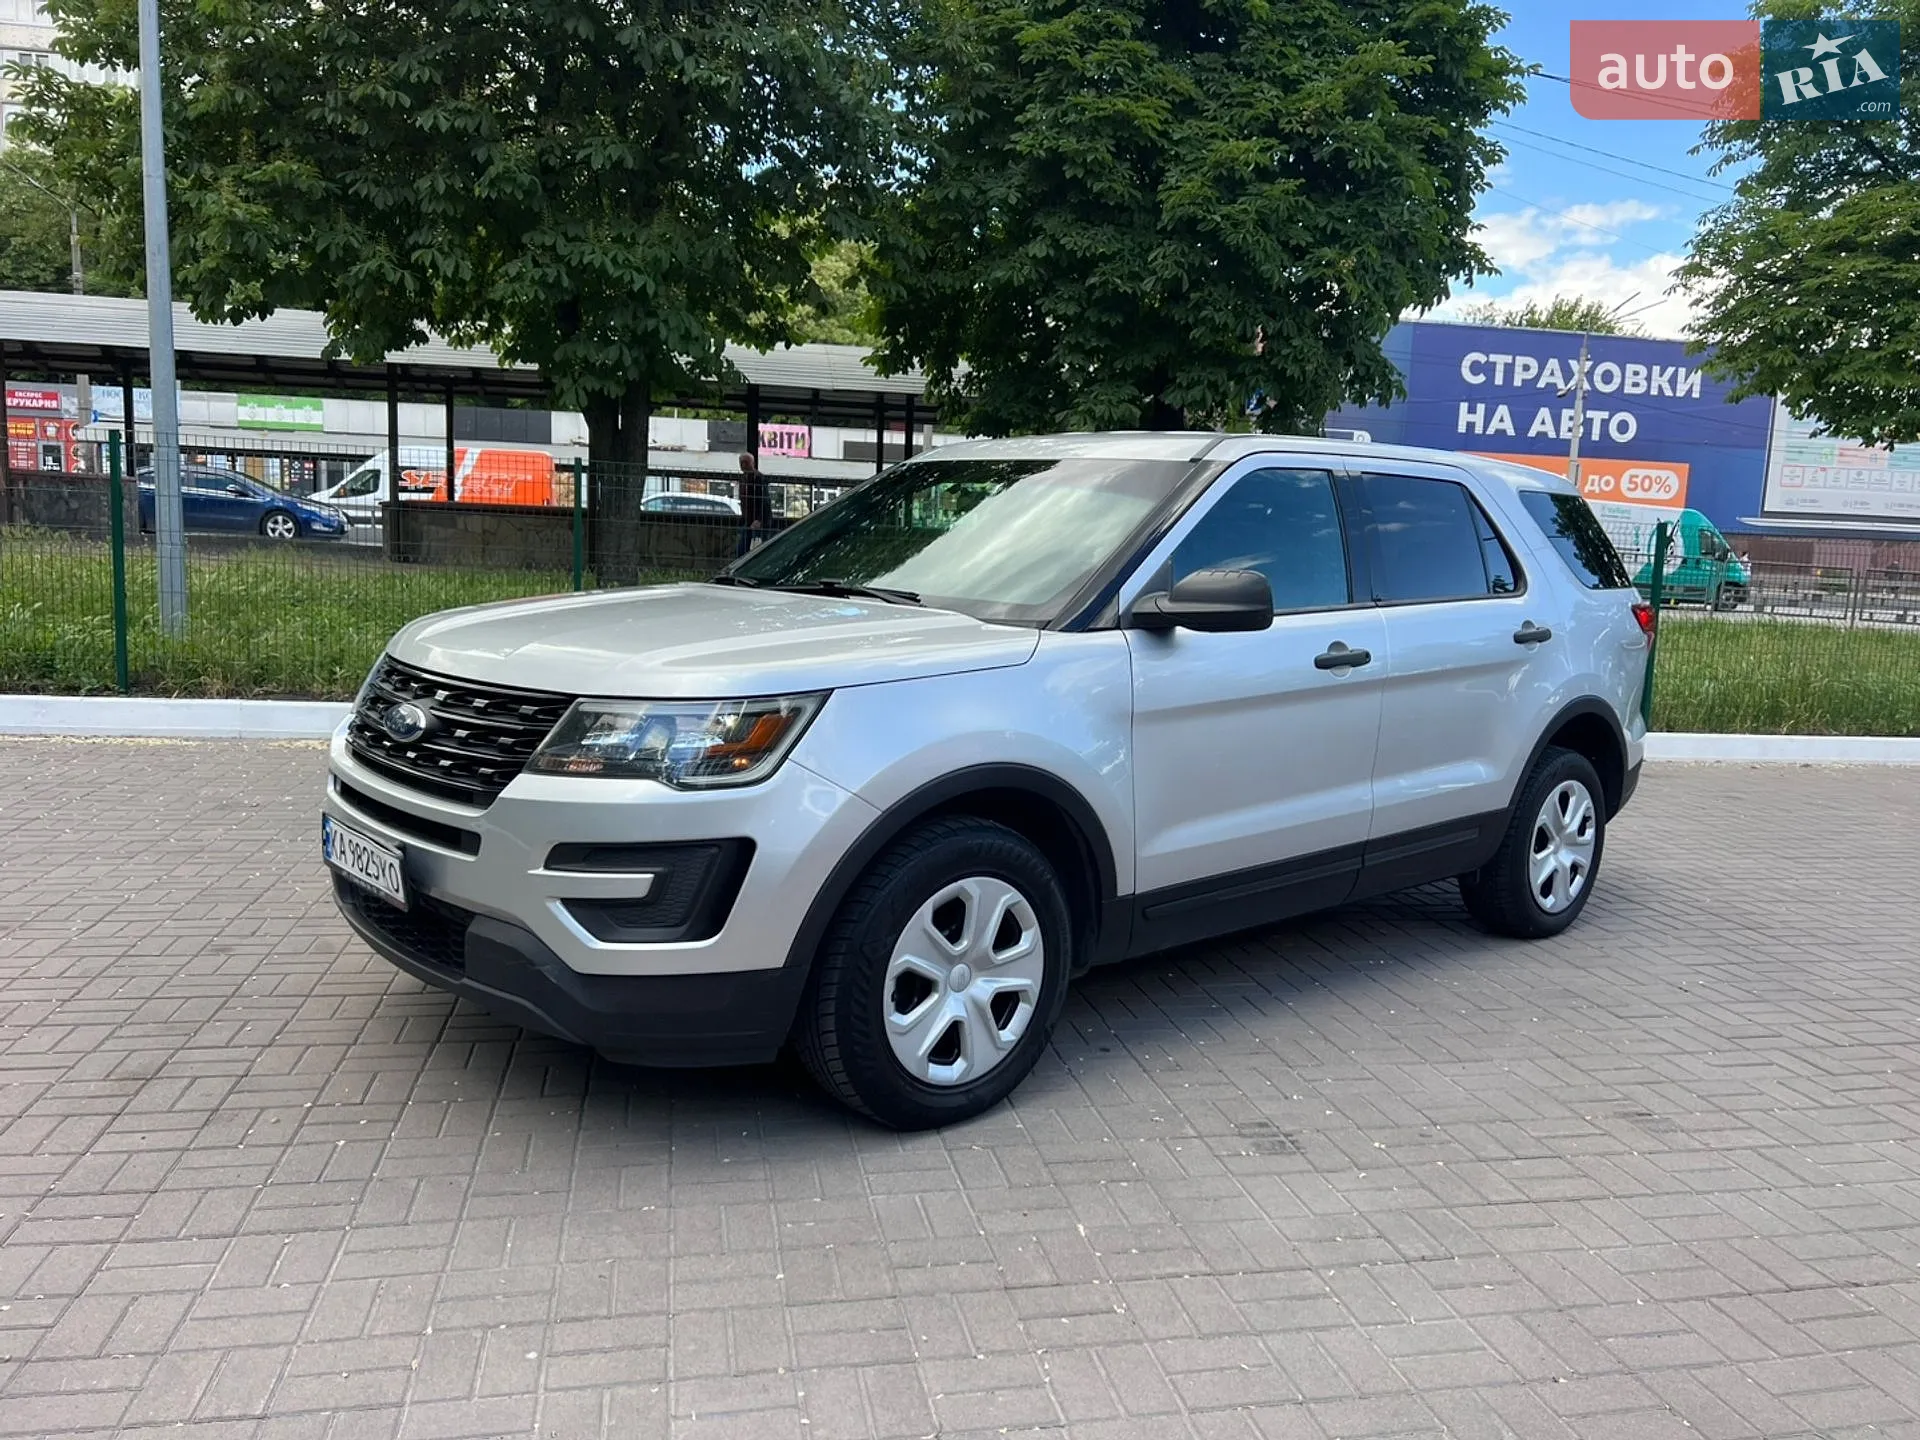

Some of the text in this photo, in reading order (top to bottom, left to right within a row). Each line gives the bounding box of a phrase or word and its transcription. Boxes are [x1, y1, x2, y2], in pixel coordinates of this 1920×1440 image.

[1460, 352, 1703, 398] СТРАХОВКИ
[1457, 402, 1638, 443] НА АВТО
[1626, 474, 1672, 494] 50%
